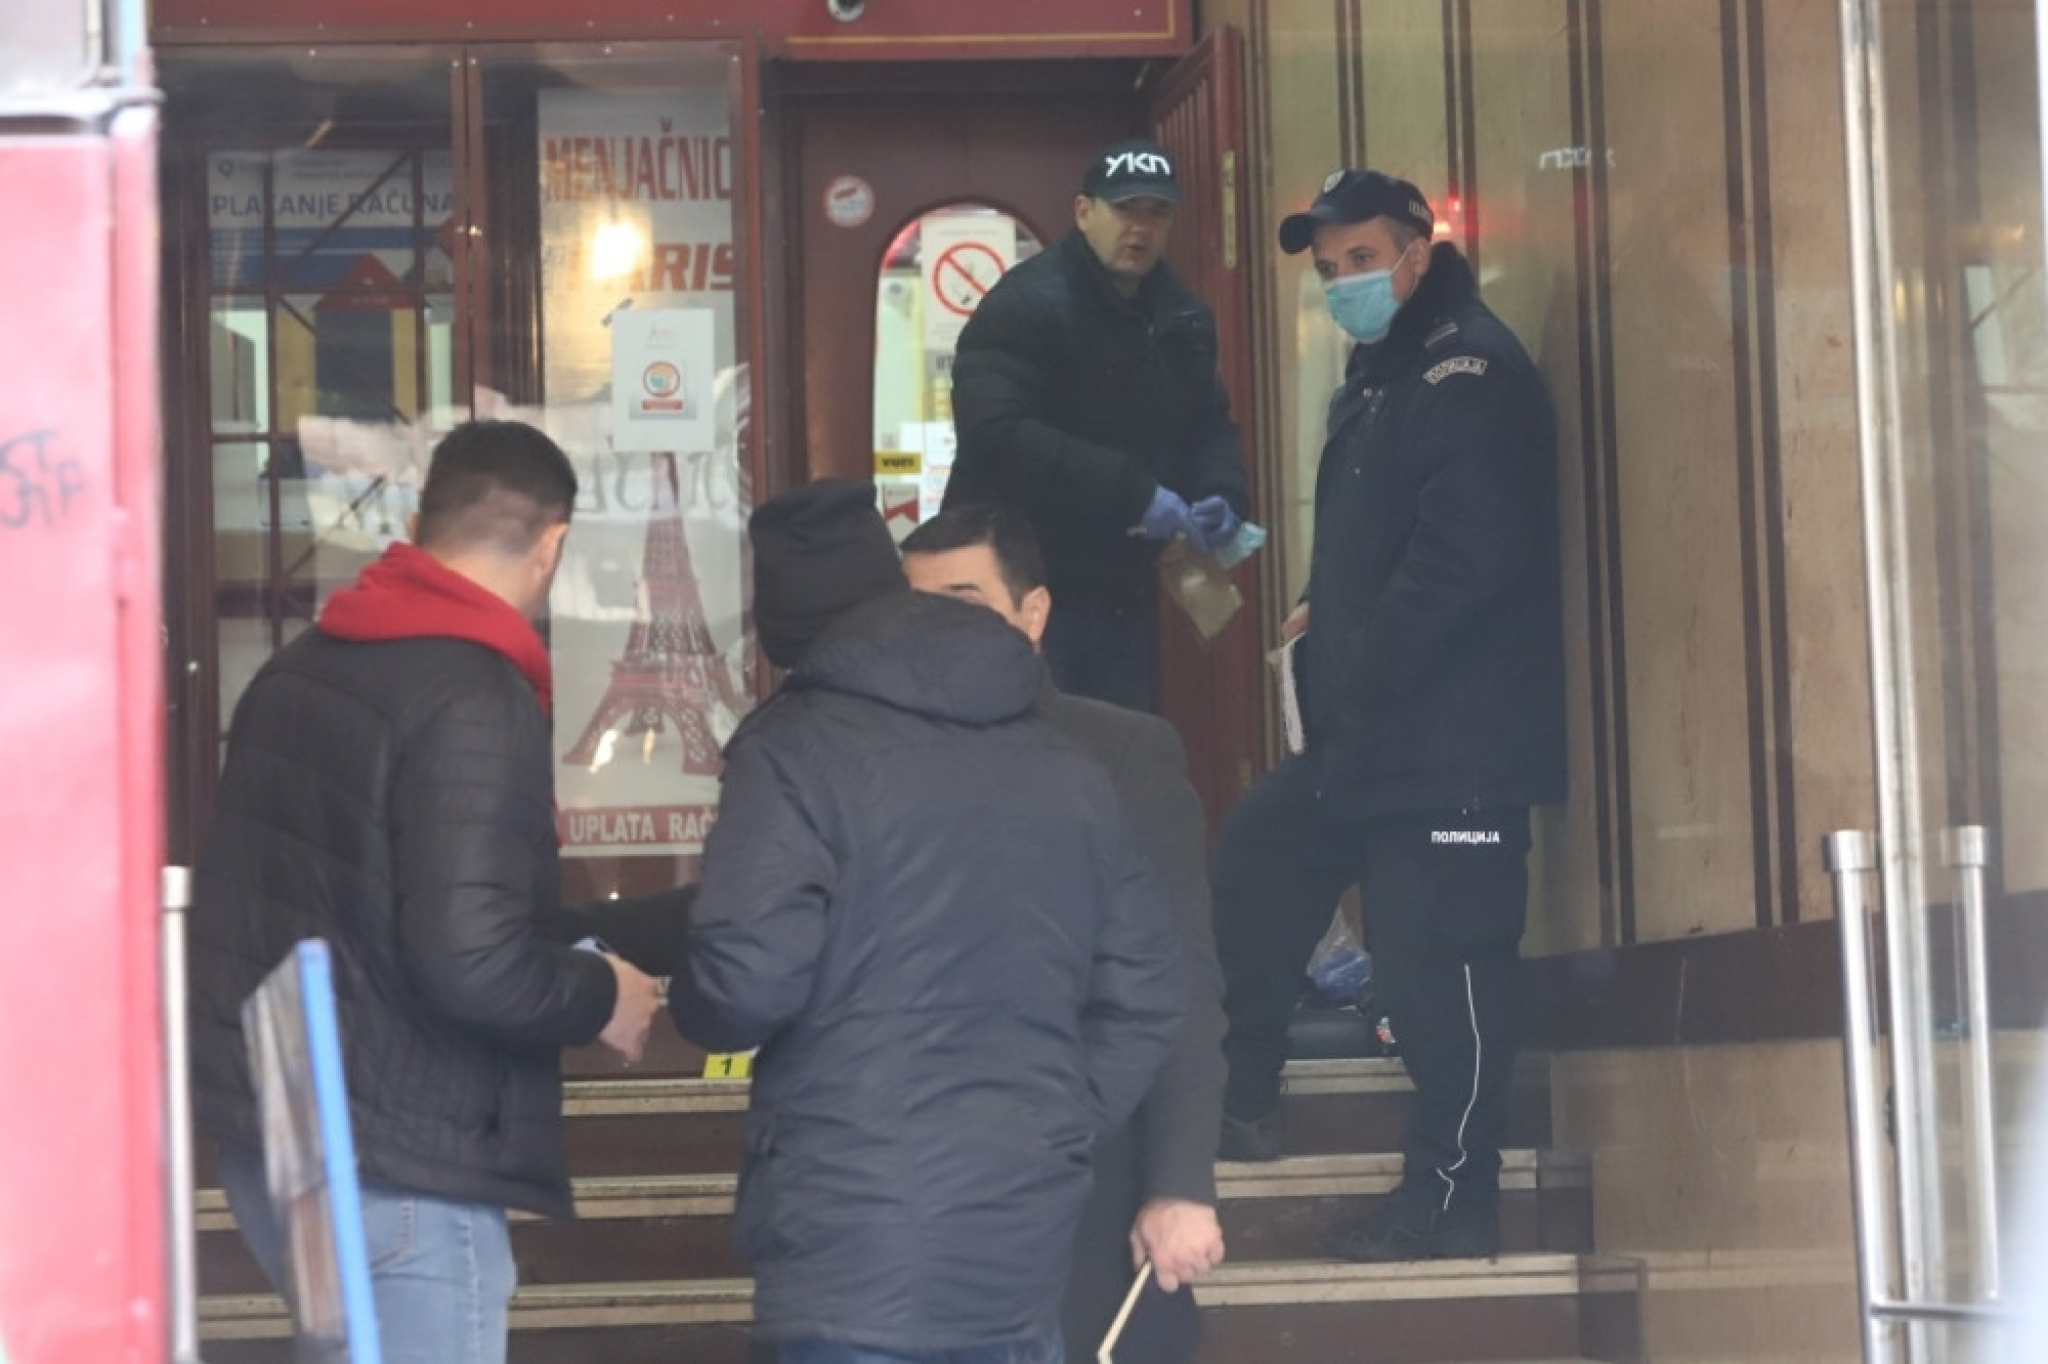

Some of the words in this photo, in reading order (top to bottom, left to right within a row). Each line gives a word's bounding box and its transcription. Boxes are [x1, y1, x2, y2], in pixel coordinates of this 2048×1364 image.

[212, 193, 339, 219] PLAANJE
[568, 811, 656, 843] UPLATA
[1431, 830, 1500, 846] ПОЛИЦИЈА
[720, 1057, 733, 1076] 1
